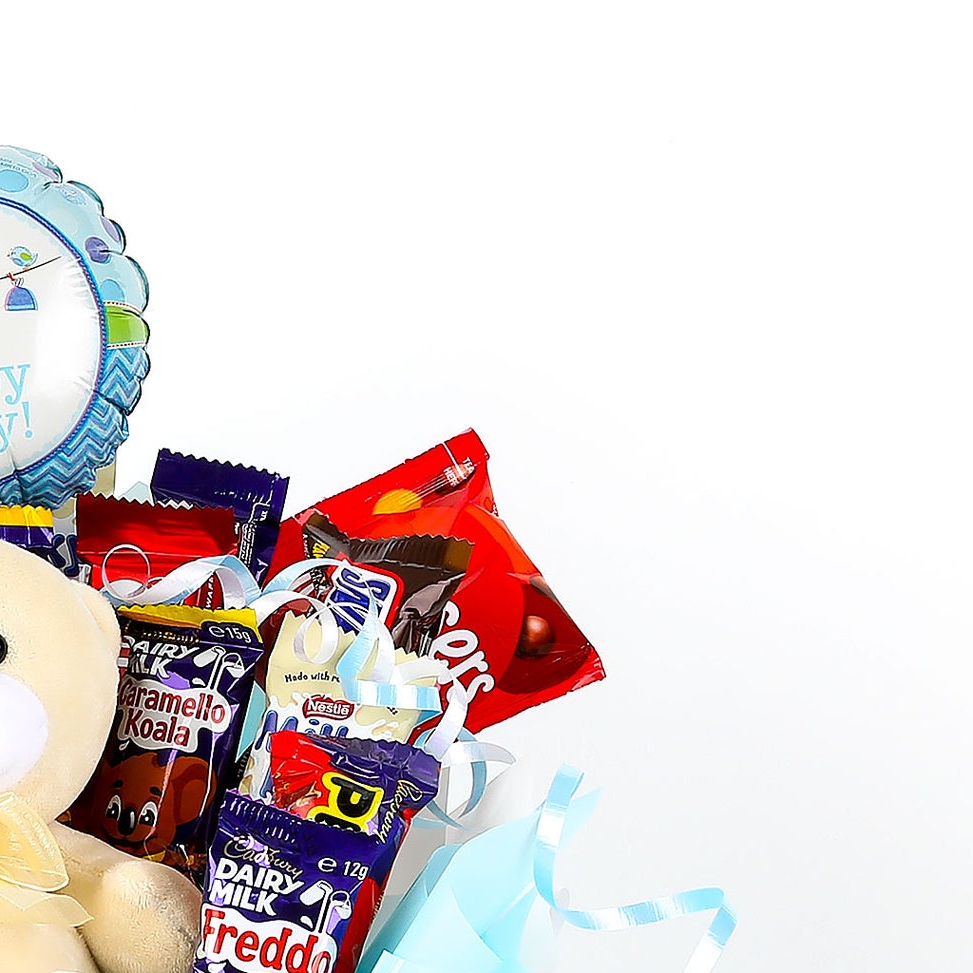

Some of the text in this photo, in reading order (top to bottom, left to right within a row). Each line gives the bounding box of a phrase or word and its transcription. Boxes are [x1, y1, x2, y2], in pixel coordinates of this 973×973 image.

[311, 671, 330, 681] with
[127, 707, 191, 747] Koala
[215, 857, 305, 895] DAIRY
[224, 835, 304, 880] Cadbury
[343, 860, 369, 880] 12g
[209, 879, 278, 916] MILK
